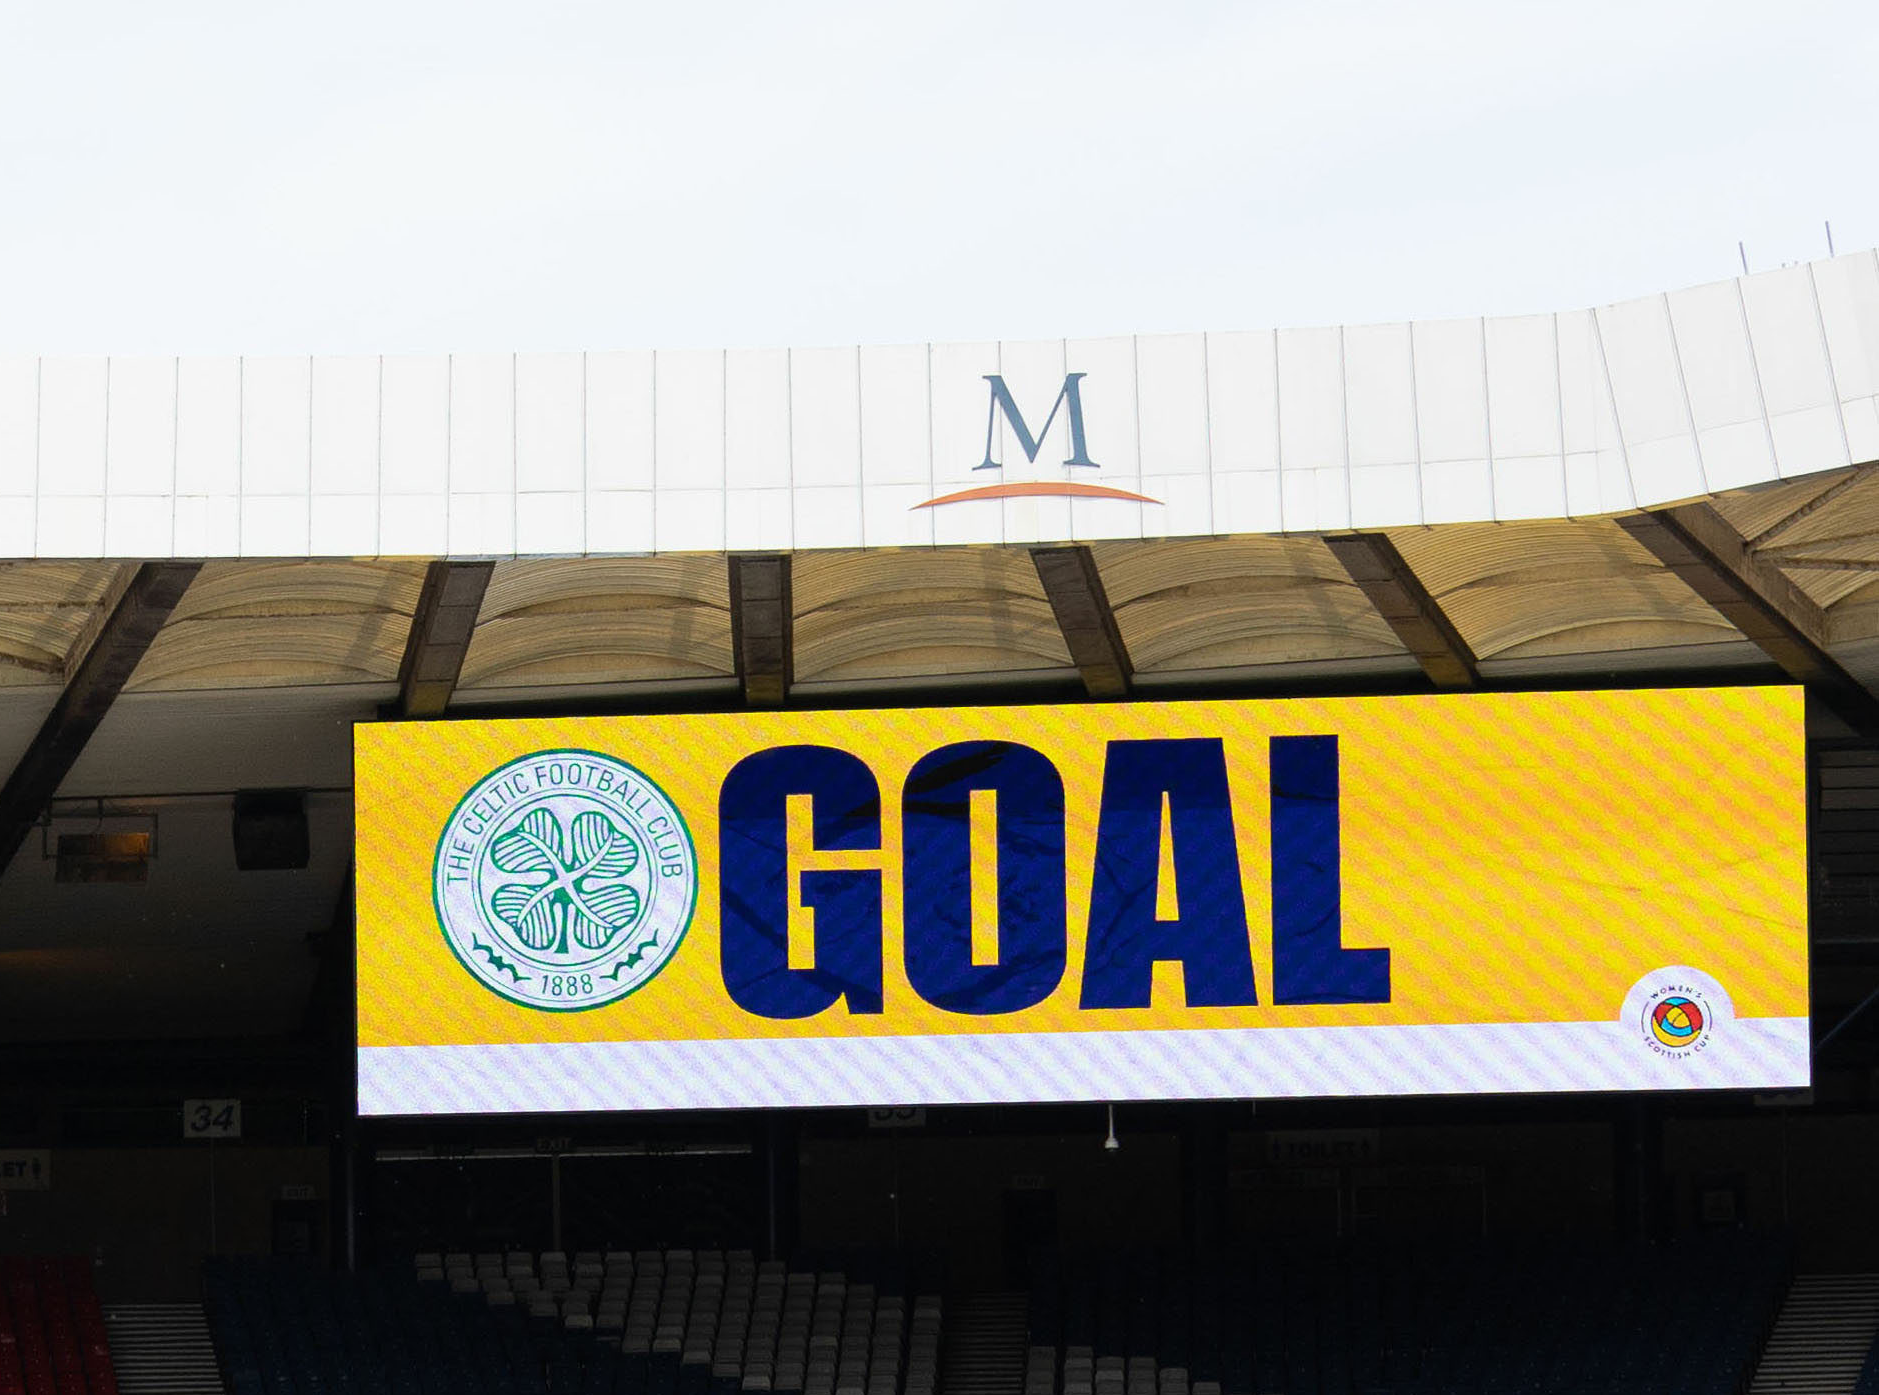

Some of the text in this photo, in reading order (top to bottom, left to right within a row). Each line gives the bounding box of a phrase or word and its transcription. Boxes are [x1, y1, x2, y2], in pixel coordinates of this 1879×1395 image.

[971, 371, 1101, 471] M
[446, 762, 683, 887] THE CELTIC FOOTBALL CLUB
[718, 734, 1391, 1020] GOAL
[541, 973, 594, 997] 1888
[1643, 1034, 1710, 1060] SCOTTISH CUP
[191, 1105, 235, 1132] 34
